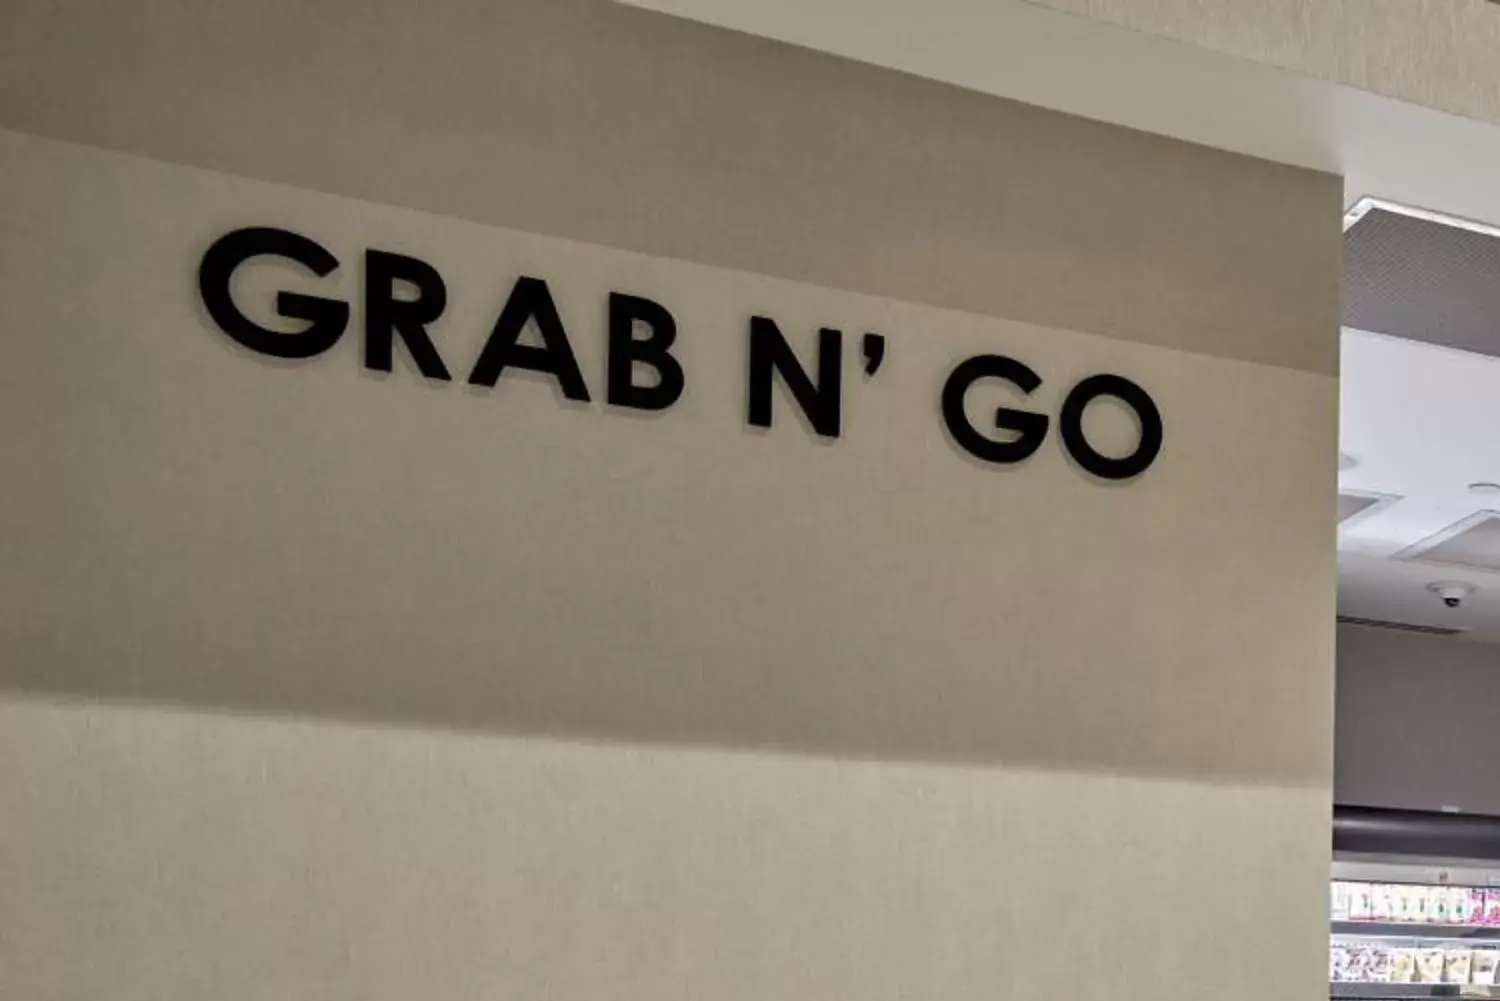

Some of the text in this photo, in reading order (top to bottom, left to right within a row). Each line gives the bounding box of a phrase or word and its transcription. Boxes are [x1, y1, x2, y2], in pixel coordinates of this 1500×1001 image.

[197, 226, 1163, 480] GRAB N' GO
